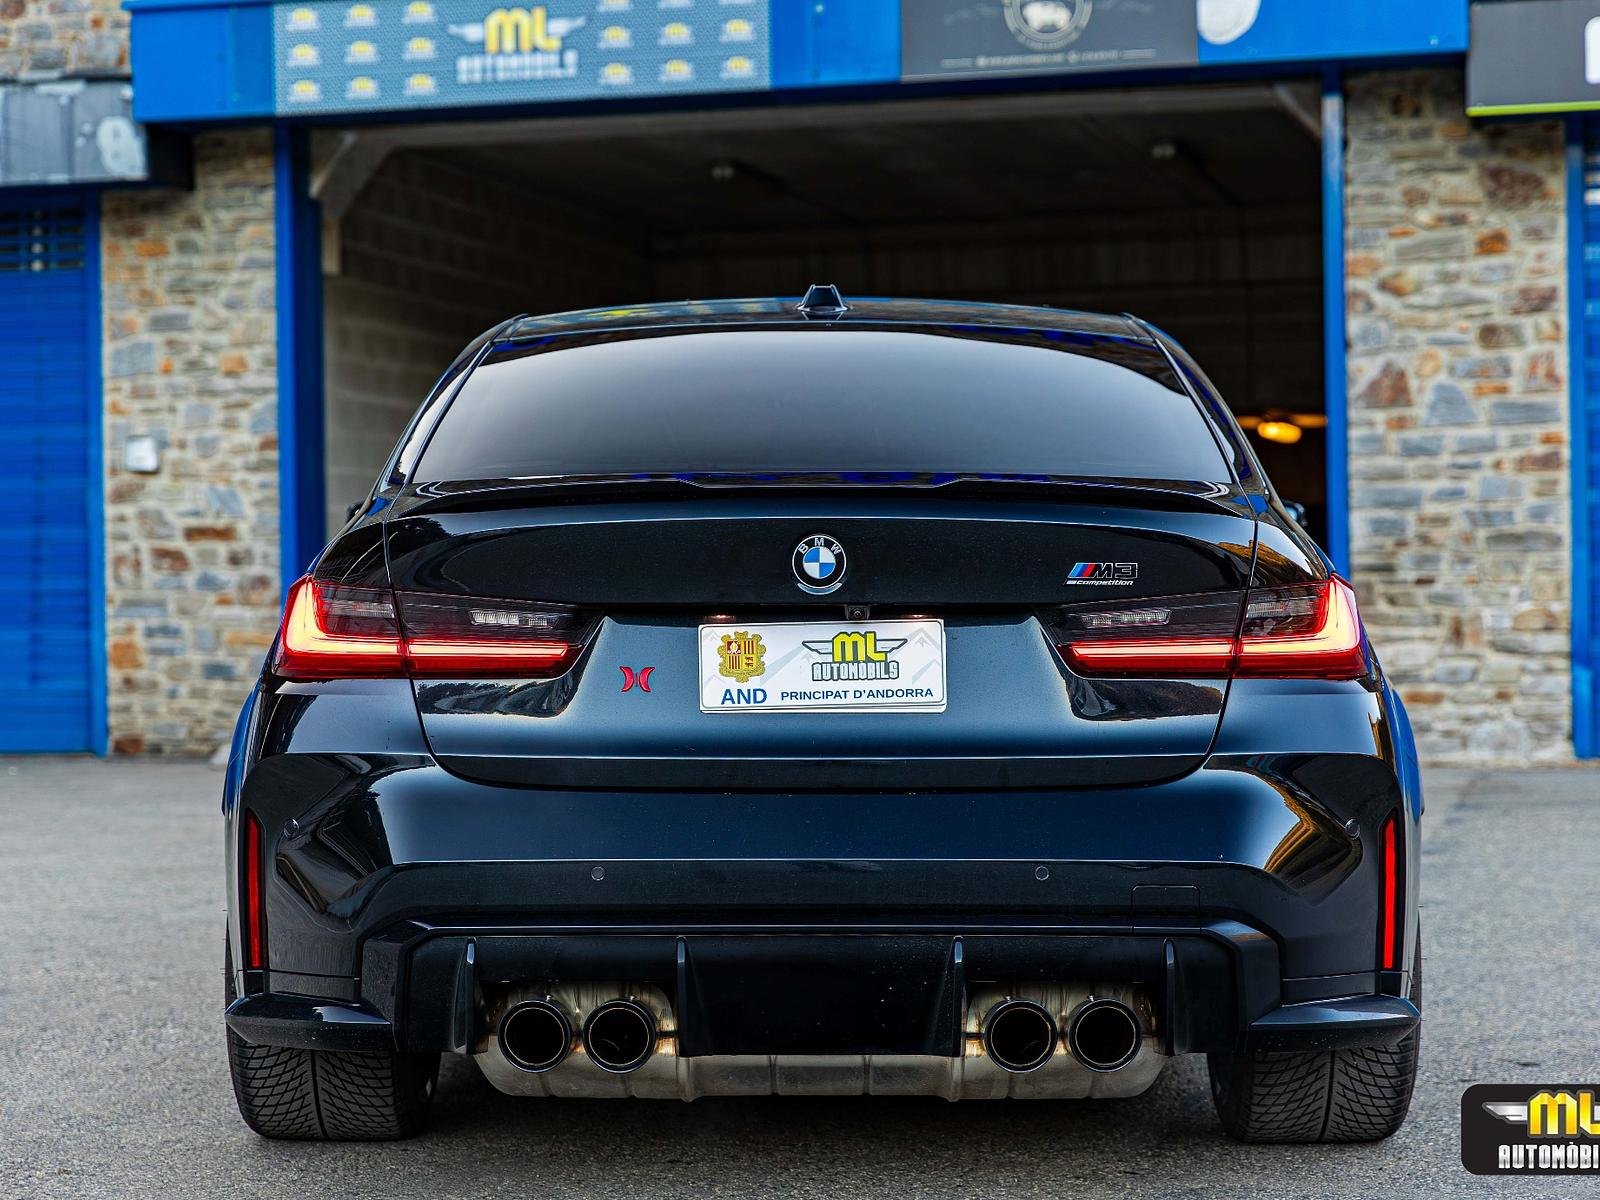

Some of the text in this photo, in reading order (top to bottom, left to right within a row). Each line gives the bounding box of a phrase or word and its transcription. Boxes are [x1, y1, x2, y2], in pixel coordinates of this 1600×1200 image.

[485, 6, 562, 54] ML
[798, 537, 842, 555] BMW
[1083, 562, 1138, 580] M3
[833, 631, 887, 662] ML
[721, 688, 767, 705] AND
[781, 688, 933, 700] PRINCIPAT D'ANDORRA
